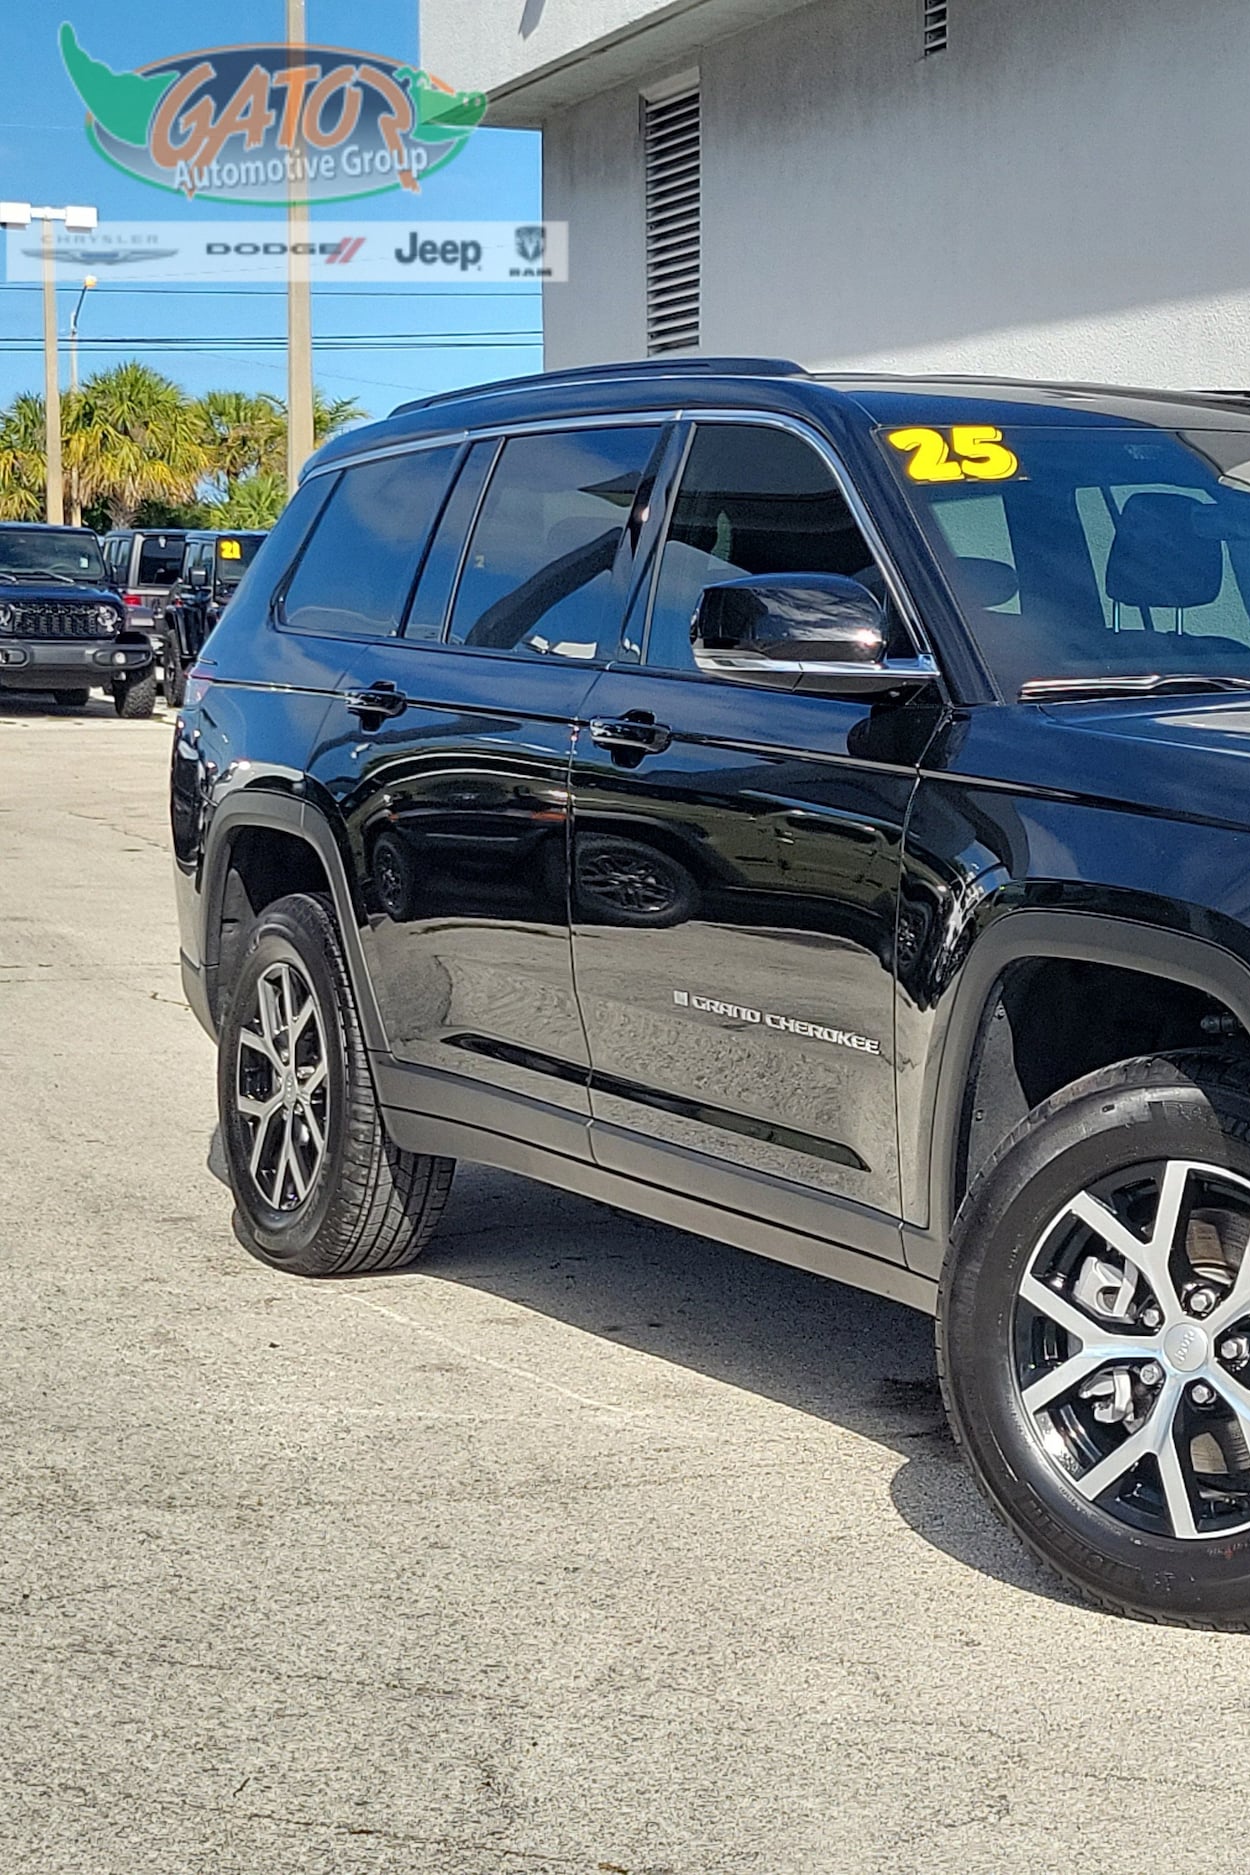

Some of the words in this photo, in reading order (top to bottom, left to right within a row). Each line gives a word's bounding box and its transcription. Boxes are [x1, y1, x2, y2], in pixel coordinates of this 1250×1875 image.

[888, 426, 1018, 481] 25
[220, 540, 241, 559] 21
[692, 995, 761, 1024] GRAND
[764, 1013, 880, 1055] CHEROKEE
